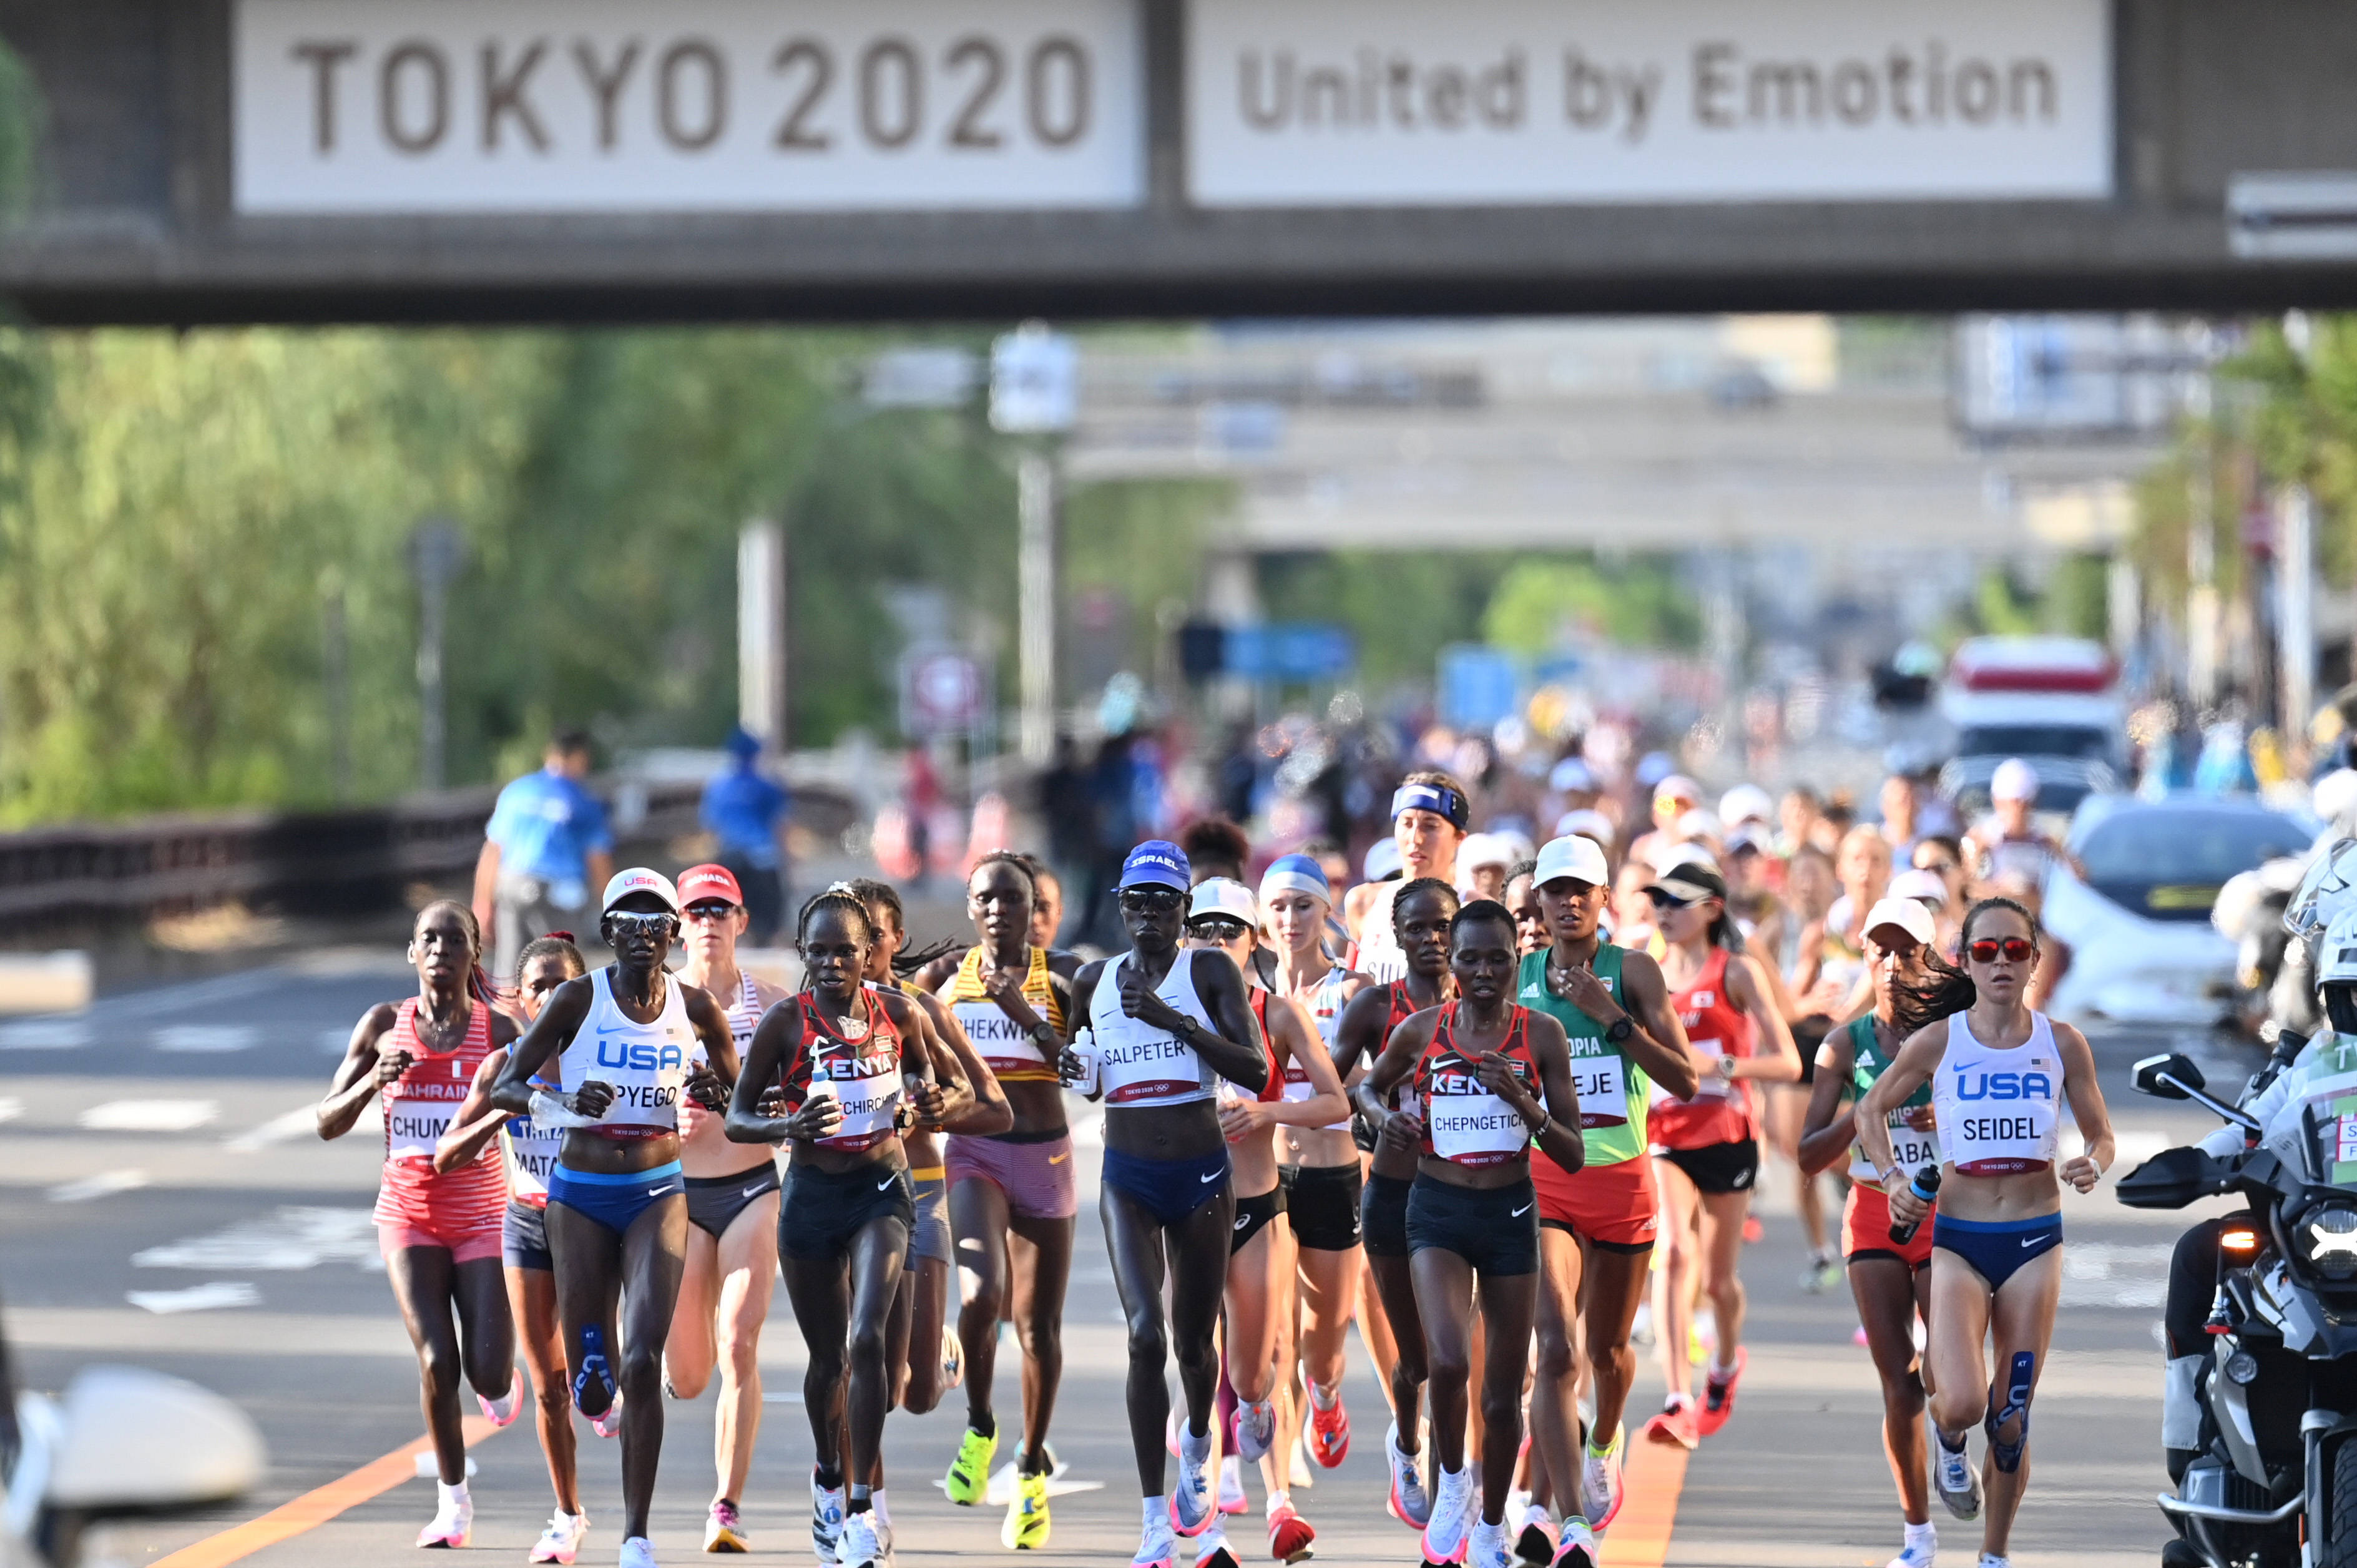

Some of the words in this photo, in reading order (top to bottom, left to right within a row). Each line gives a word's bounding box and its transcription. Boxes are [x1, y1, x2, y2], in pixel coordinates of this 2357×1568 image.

[288, 36, 729, 157] TOKYO
[772, 35, 1092, 152] 2020
[1238, 49, 1527, 131] United
[1563, 47, 1664, 146] by
[1690, 40, 2059, 125] Emotion
[1130, 855, 1178, 871] ISRAEL
[624, 876, 657, 886] USA
[597, 1041, 682, 1071] USA
[1104, 1040, 1186, 1066] SALPETER
[1567, 1037, 1602, 1057] OPIA
[1431, 1073, 1487, 1094] KEN
[1572, 1072, 1612, 1096] EJE
[1957, 1073, 2051, 1100] USA
[615, 1085, 677, 1107] PYEGO
[393, 1116, 450, 1138] CHUM
[1963, 1117, 2041, 1140] SEIDEL
[514, 1152, 557, 1177] MATA
[2017, 1360, 2027, 1368] KT
